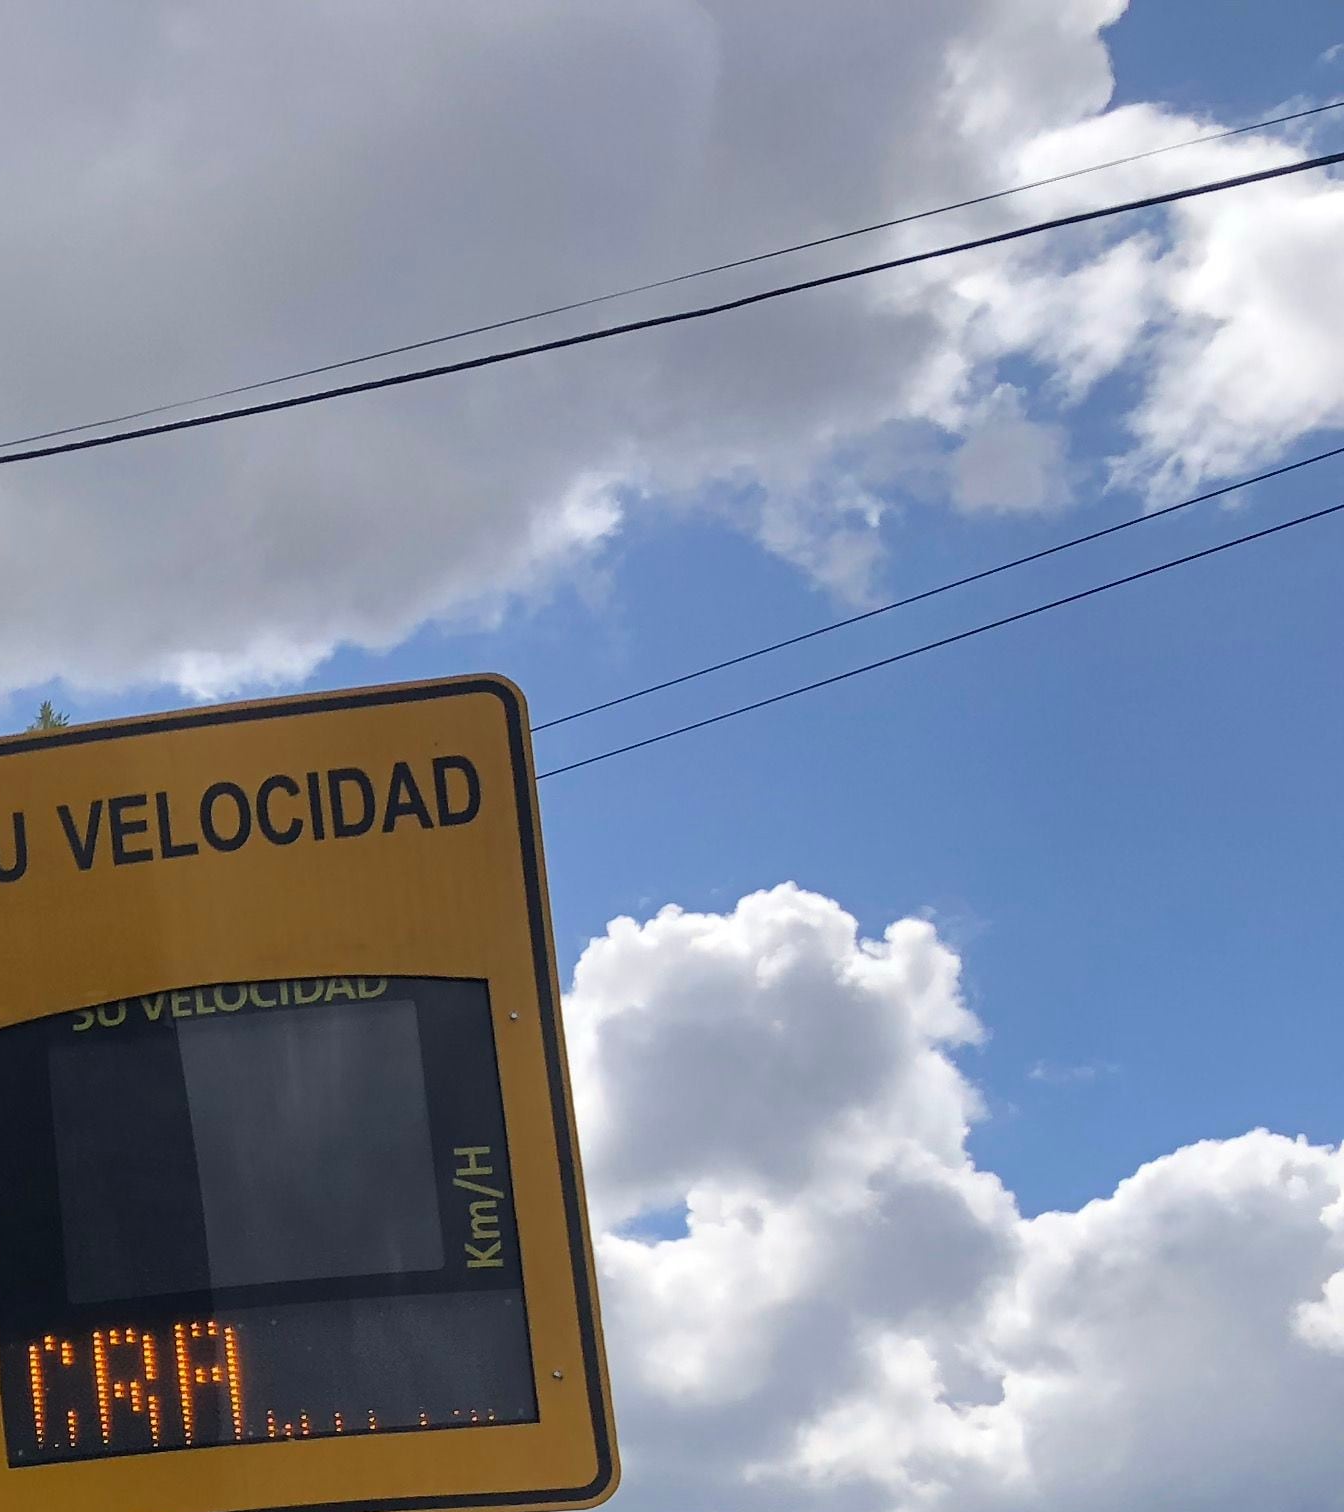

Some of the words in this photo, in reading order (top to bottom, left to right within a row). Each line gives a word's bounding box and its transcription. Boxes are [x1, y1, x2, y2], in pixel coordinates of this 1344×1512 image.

[56, 754, 482, 871] VELOCIDAD
[140, 978, 389, 1021] VELOCIDAD
[452, 1146, 505, 1268] Km/H
